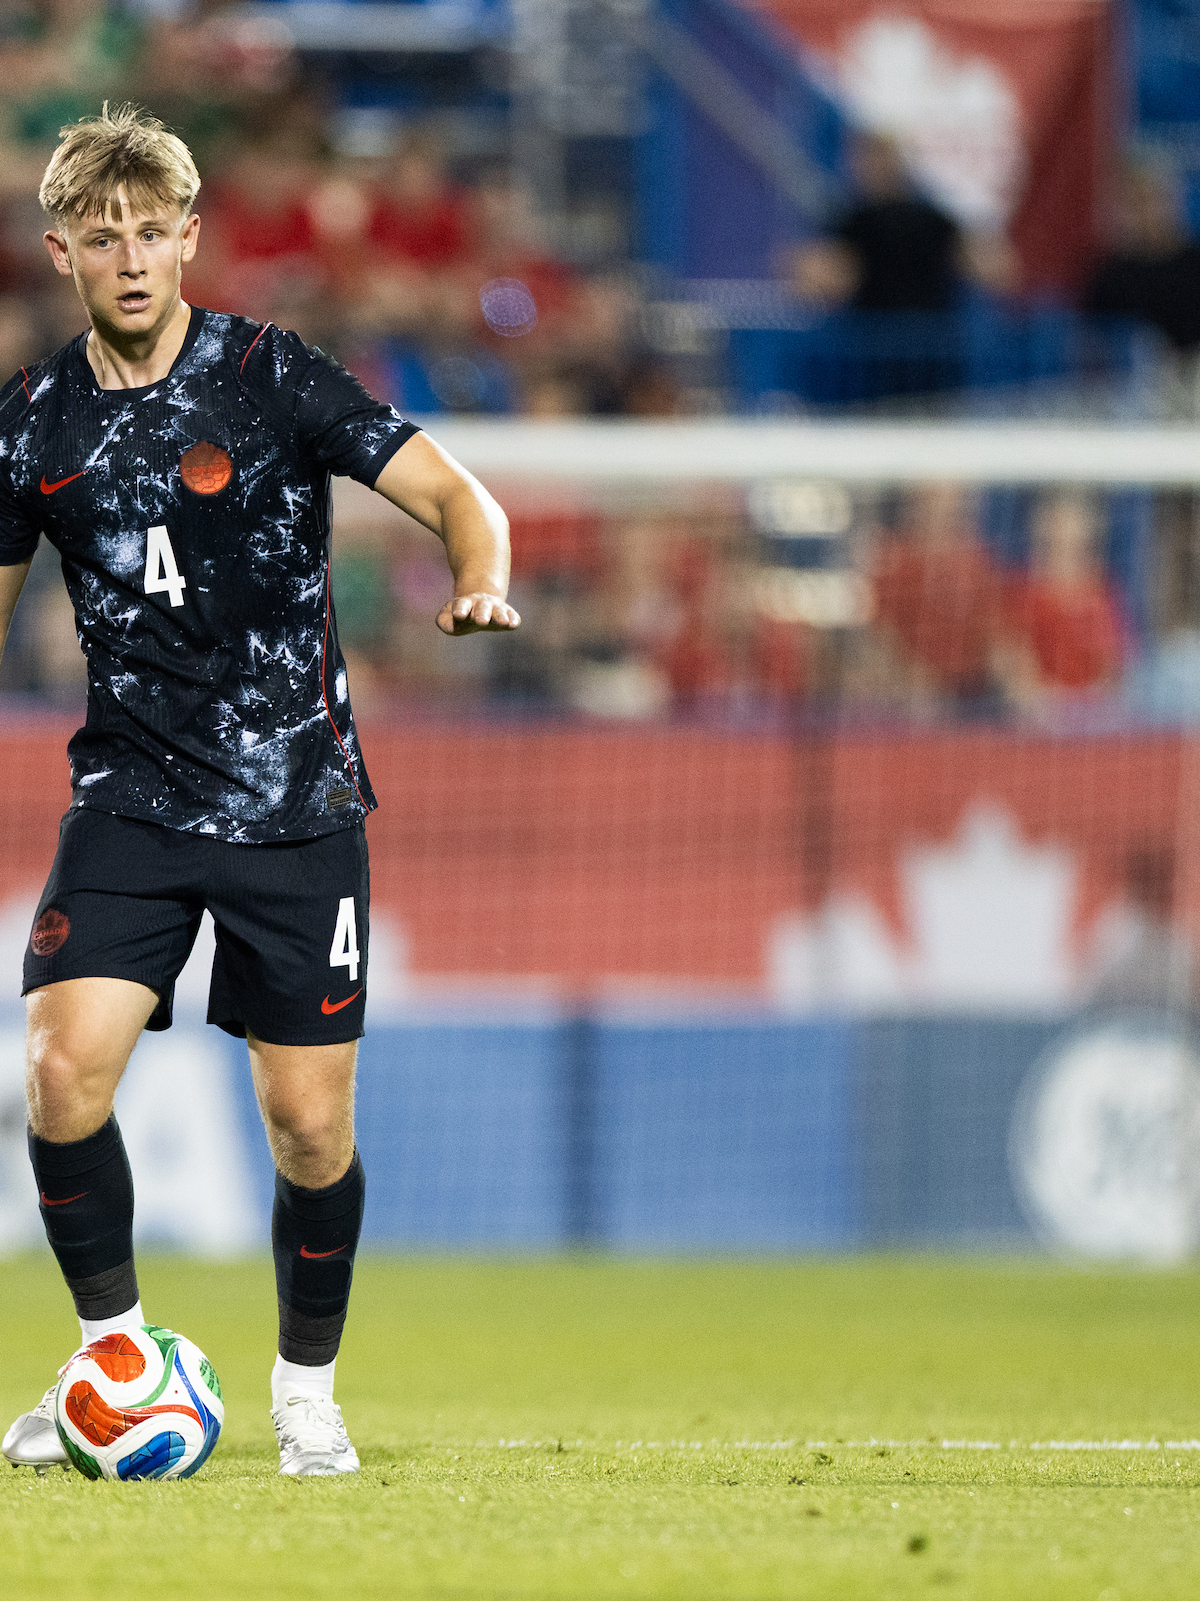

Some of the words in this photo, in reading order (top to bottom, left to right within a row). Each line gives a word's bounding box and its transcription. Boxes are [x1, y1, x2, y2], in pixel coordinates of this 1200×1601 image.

[144, 525, 187, 608] 4
[33, 927, 67, 940] CANADA
[329, 897, 360, 981] 4
